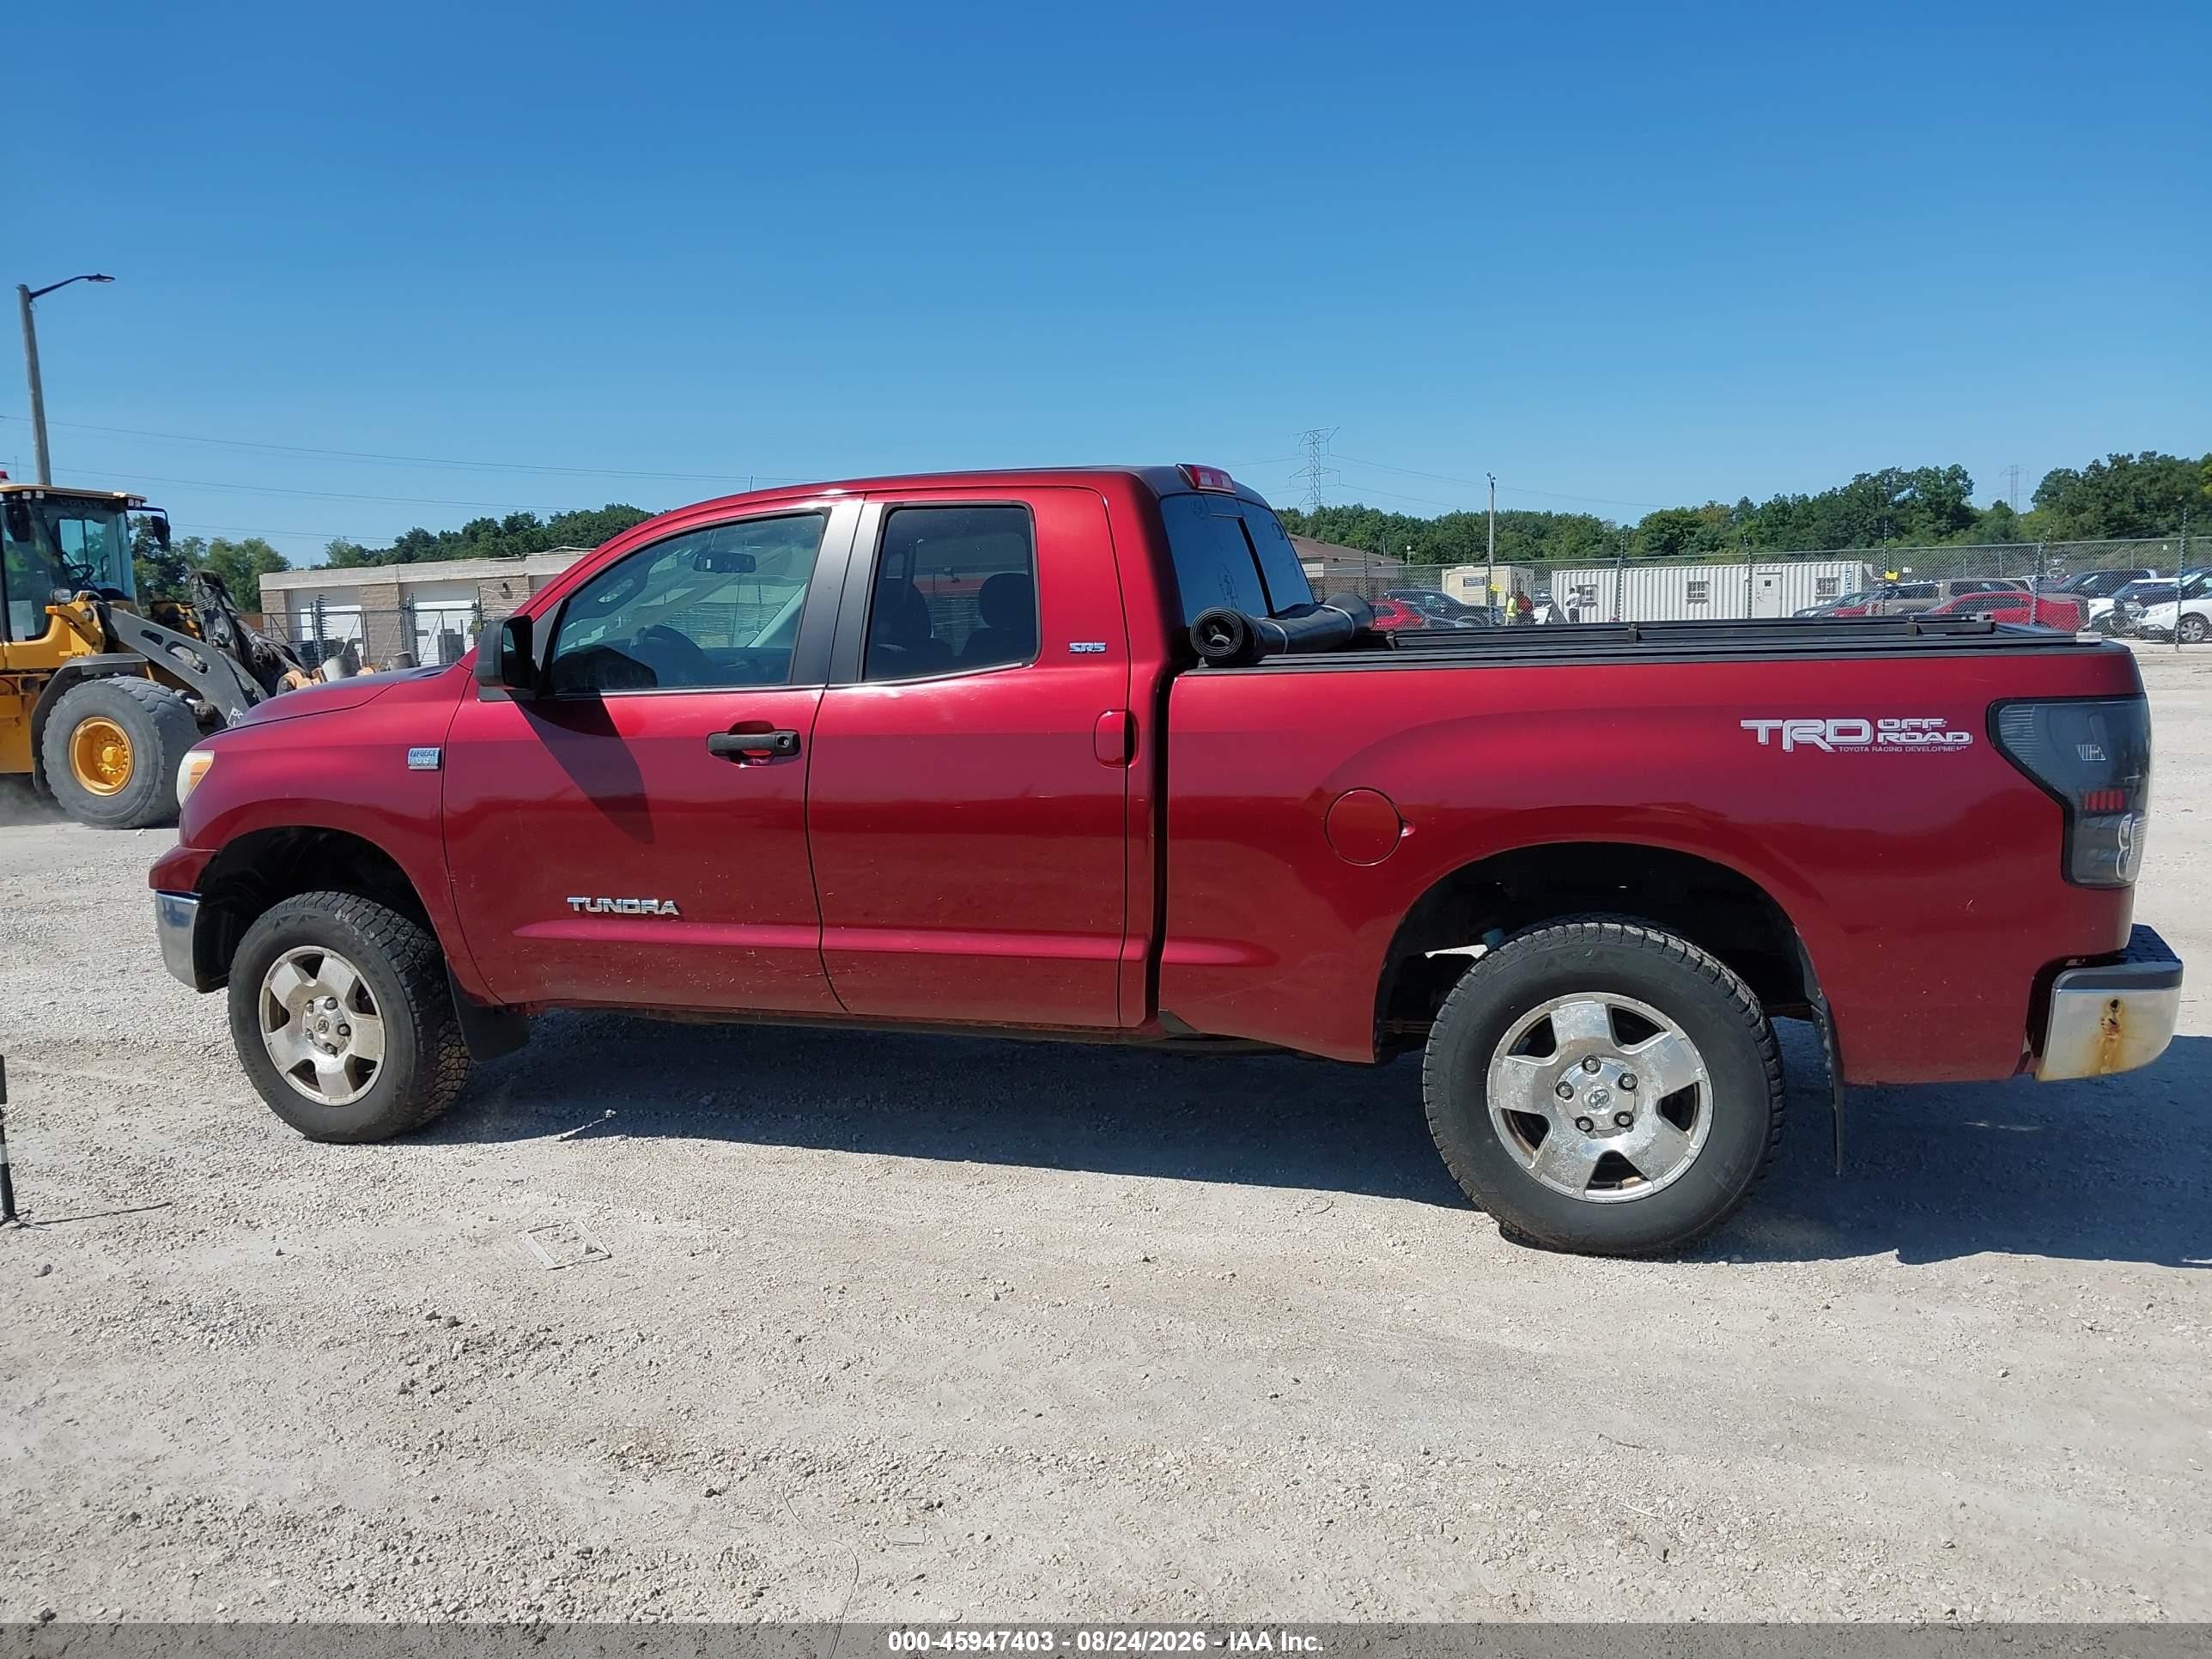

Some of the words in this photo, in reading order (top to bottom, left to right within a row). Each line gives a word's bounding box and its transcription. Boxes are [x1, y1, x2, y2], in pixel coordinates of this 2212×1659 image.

[1069, 642, 1106, 653] SR5
[1740, 719, 1874, 752] TRD
[1877, 718, 1948, 731] OFF
[1877, 732, 1973, 745] ROAD
[567, 896, 680, 915] TUNDRA
